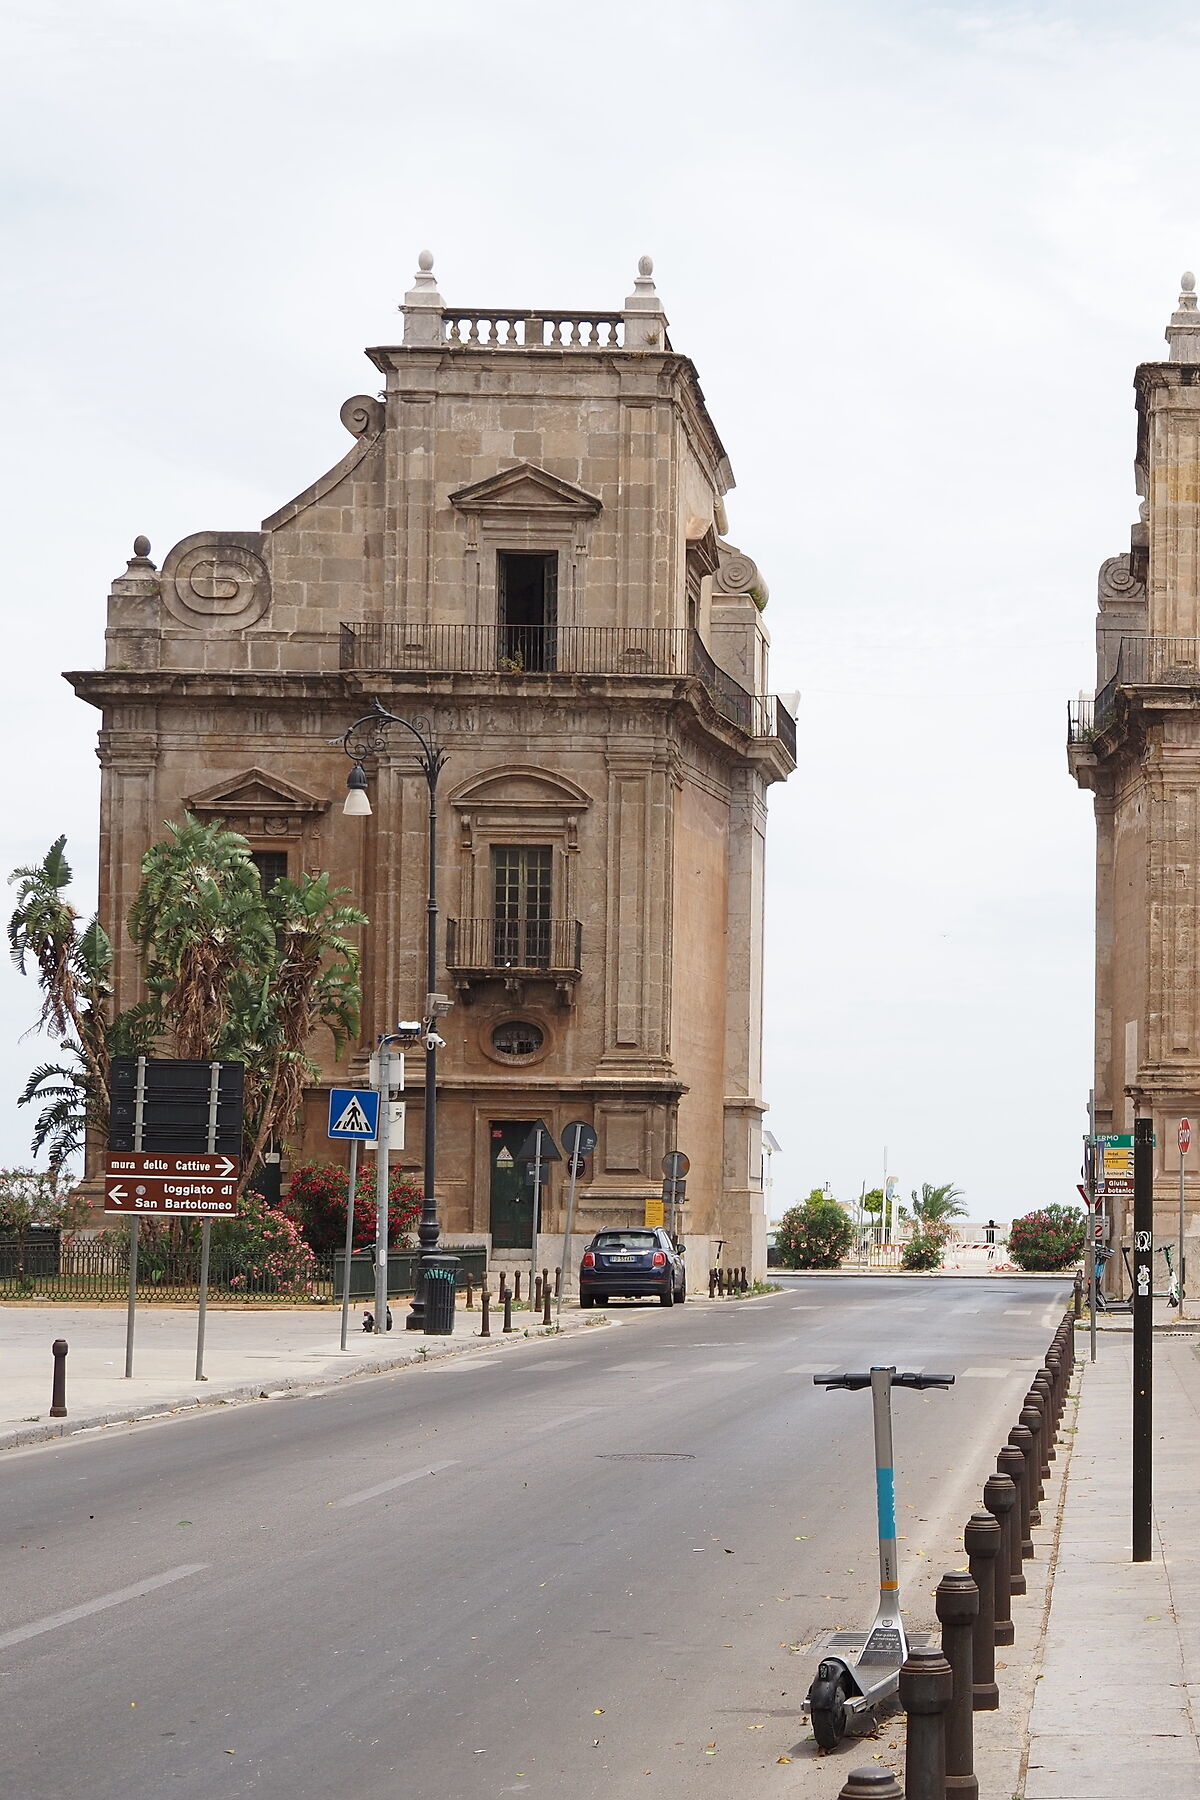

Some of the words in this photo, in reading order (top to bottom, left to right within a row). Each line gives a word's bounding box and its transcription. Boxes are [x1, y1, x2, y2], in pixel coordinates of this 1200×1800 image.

[1179, 1129, 1190, 1143] STOP
[111, 1161, 136, 1169] mura
[143, 1159, 169, 1170] delle
[175, 1160, 211, 1171] Cattive
[164, 1183, 214, 1196] loggiato
[221, 1184, 233, 1195] di
[135, 1197, 158, 1208] San
[165, 1198, 233, 1210] Bartolomeo
